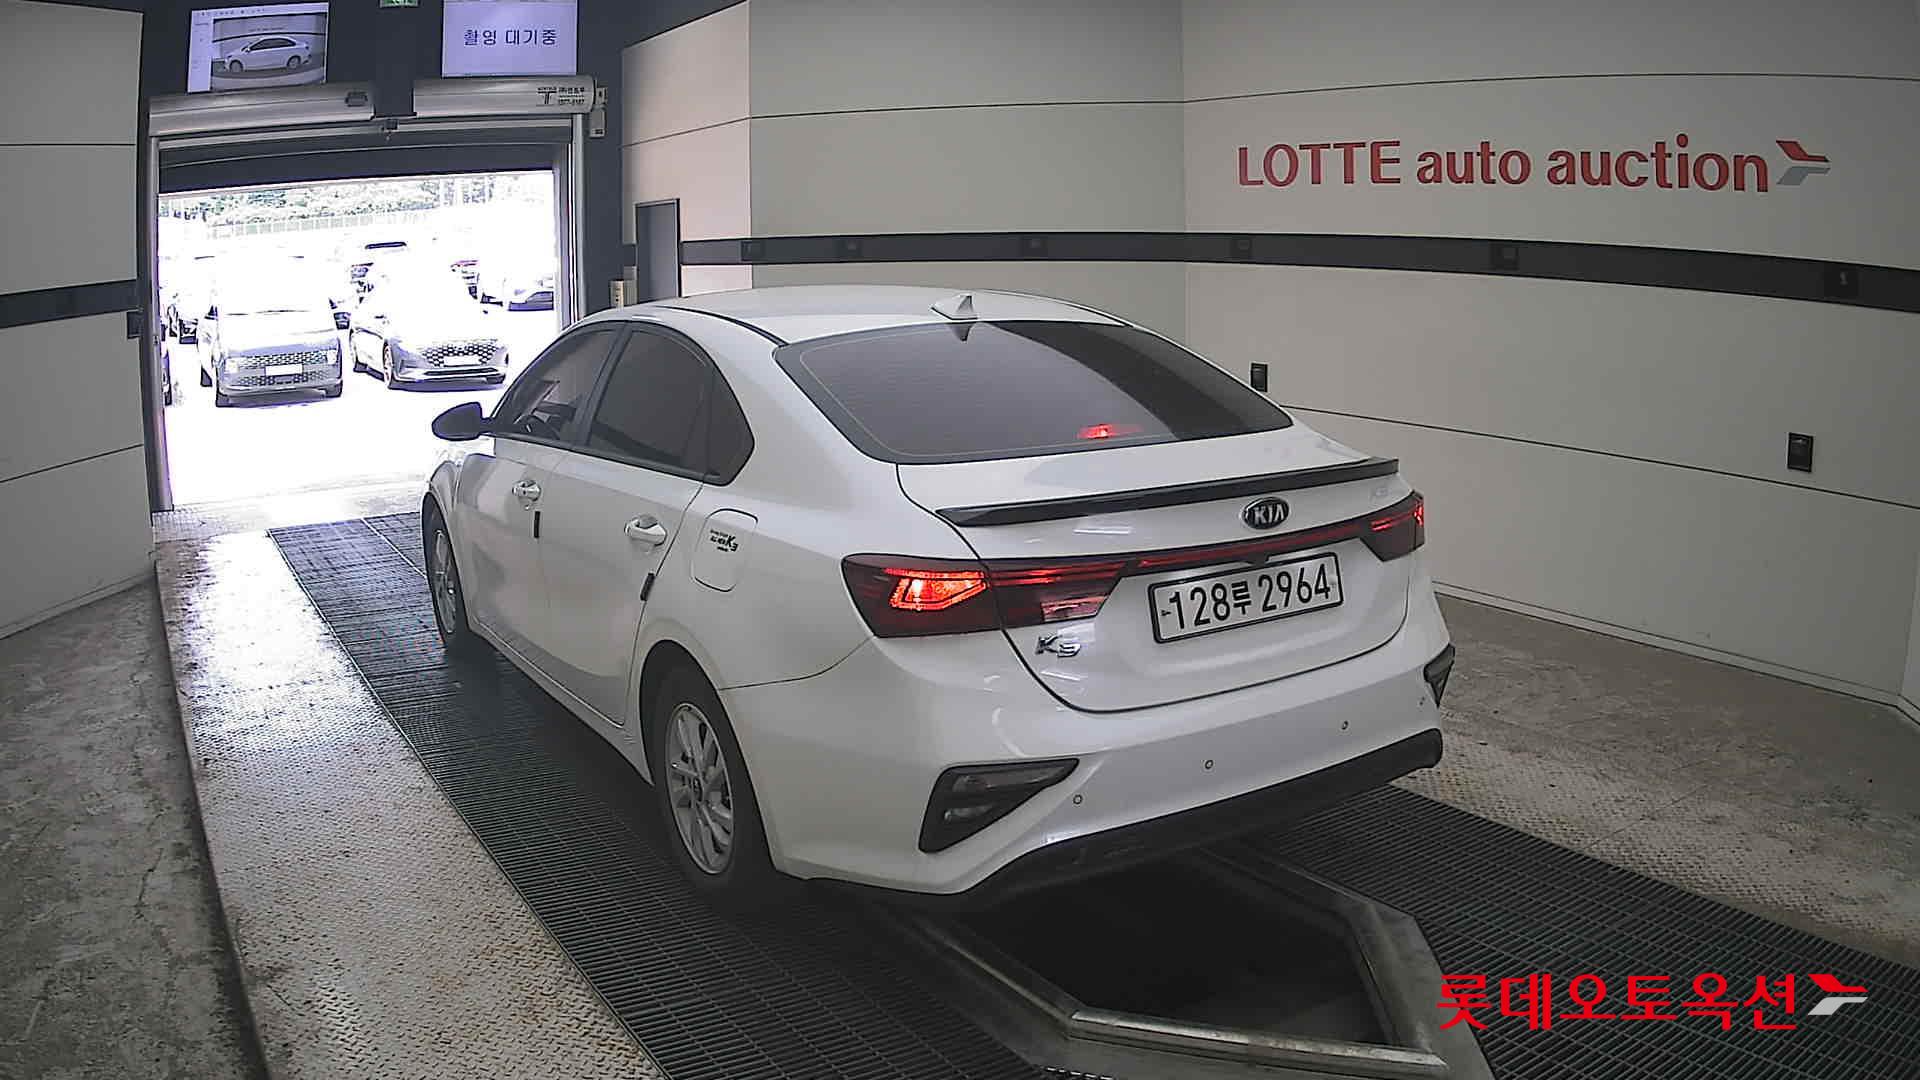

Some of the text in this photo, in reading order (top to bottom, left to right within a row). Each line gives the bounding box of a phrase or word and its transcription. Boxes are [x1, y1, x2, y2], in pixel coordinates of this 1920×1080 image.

[505, 29, 556, 45] 대기중
[1238, 133, 1768, 192] LOTTE auto auction
[1253, 503, 1285, 525] KIA
[1168, 563, 1331, 630] 128루 2964
